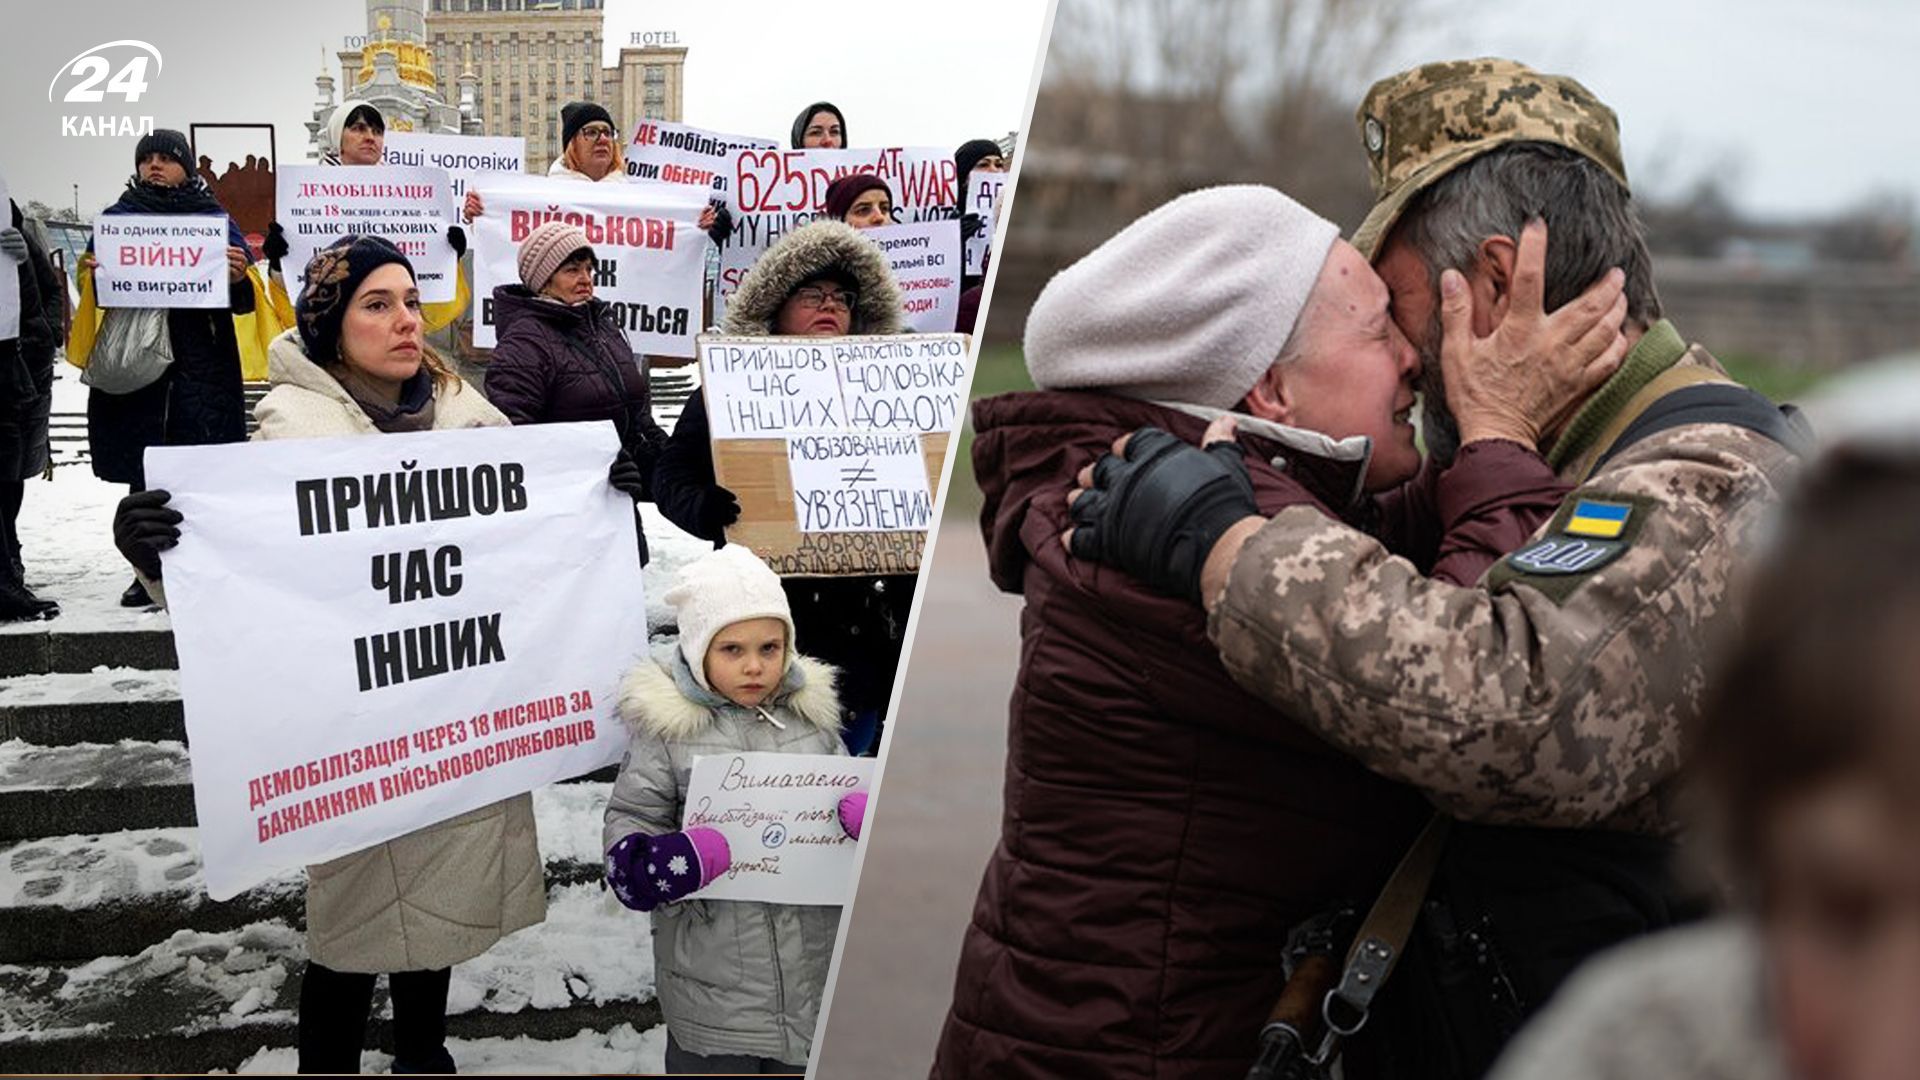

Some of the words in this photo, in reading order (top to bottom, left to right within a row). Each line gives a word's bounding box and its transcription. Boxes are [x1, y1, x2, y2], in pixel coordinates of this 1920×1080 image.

[630, 31, 680, 44] HOTEL
[633, 122, 657, 146] ДЕ
[659, 130, 777, 157] мобіліз
[431, 152, 518, 170] чоловіки
[625, 158, 659, 179] оли
[297, 183, 433, 199] ДЕМОБІЛІЗАЦІЯ
[737, 151, 808, 212] 625
[876, 148, 903, 179] AT
[899, 160, 958, 207] WAR
[325, 205, 339, 217] 18
[101, 224, 119, 235] На
[123, 225, 167, 237] одних
[171, 226, 221, 237] плечах
[298, 223, 343, 235] ШАНС
[350, 219, 438, 234] ВІЙСЬКОВИХ
[120, 242, 203, 267] ВІЙНУ
[872, 237, 930, 251] еремогу
[927, 254, 945, 267] ВСІ
[112, 279, 132, 291] не
[138, 280, 213, 295] виграти!
[903, 298, 933, 313] ЮДИ
[708, 346, 827, 373] ПРИЙШОВ
[919, 341, 961, 357] МОГО
[748, 374, 800, 397] ЧАС
[847, 359, 965, 393] ЧОЛОВІКА
[726, 393, 838, 432] ІНШИХ
[852, 392, 960, 432] ДОДОМ
[790, 434, 918, 461] МОБІЗОВАНИЙ
[295, 460, 528, 536] ПРИЙШОВ
[370, 545, 463, 604] ЧАС
[768, 551, 880, 574] МОБІЛІЗАЦІЯ
[354, 612, 506, 692] ІНШИХ
[248, 736, 409, 811] ДЕМОБІЛІЗАЦІЯ
[413, 719, 467, 757] ЧЕРЕЗ
[469, 715, 490, 738] 18
[493, 694, 567, 732] МІСЯЦІВ
[570, 690, 593, 713] ЗА
[257, 781, 377, 844] БАЖАННЯМ
[381, 719, 596, 802] ВІЙСЬКОВОСЛУЖБОВЦІВ
[719, 757, 860, 791] Вимагаємо
